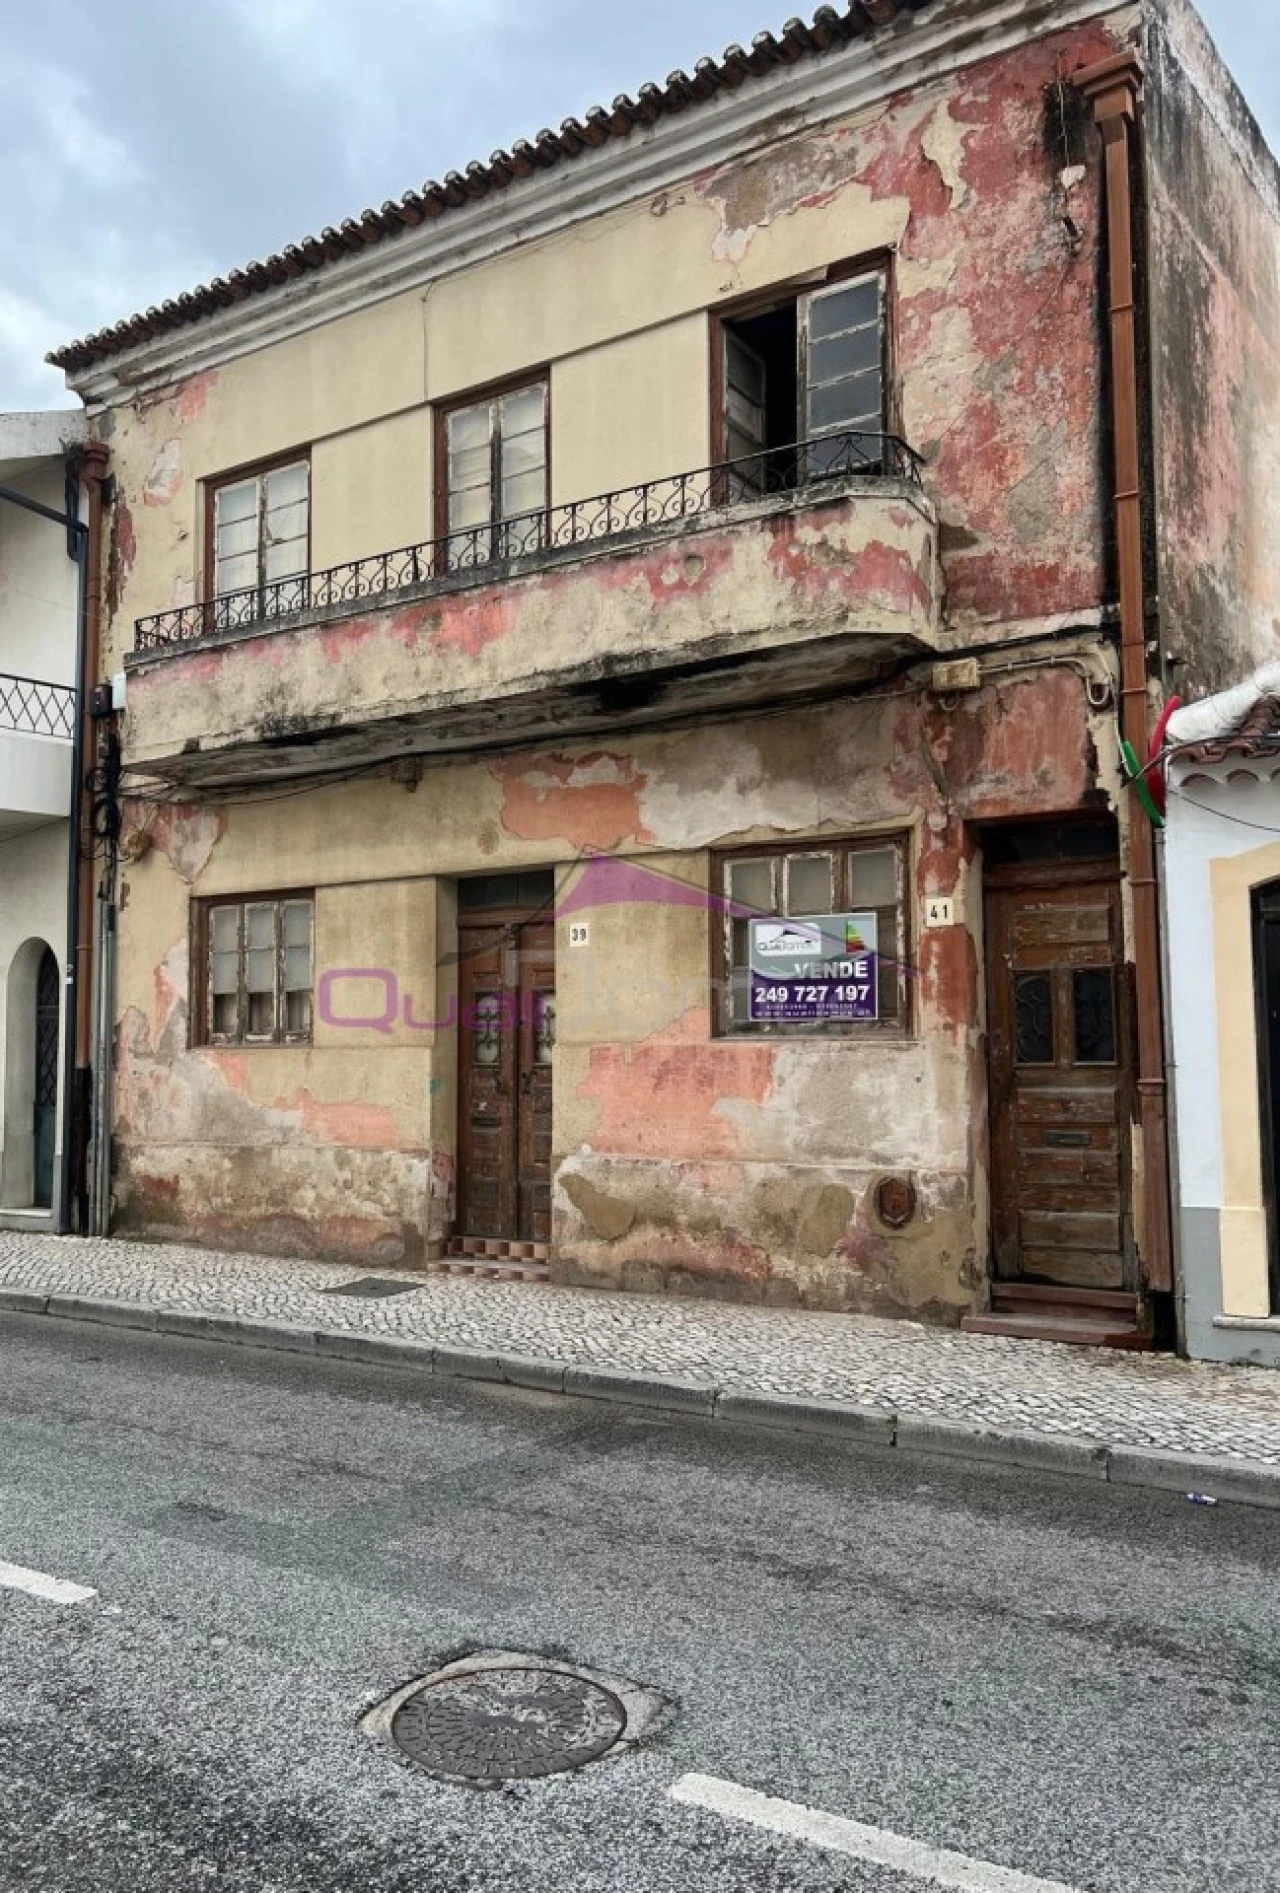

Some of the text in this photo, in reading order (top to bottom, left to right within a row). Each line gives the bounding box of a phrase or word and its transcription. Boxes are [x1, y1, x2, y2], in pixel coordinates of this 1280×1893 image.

[930, 904, 948, 920] 41
[571, 928, 587, 942] 39
[794, 961, 869, 979] VENDE
[754, 985, 871, 1003] 249 727 197
